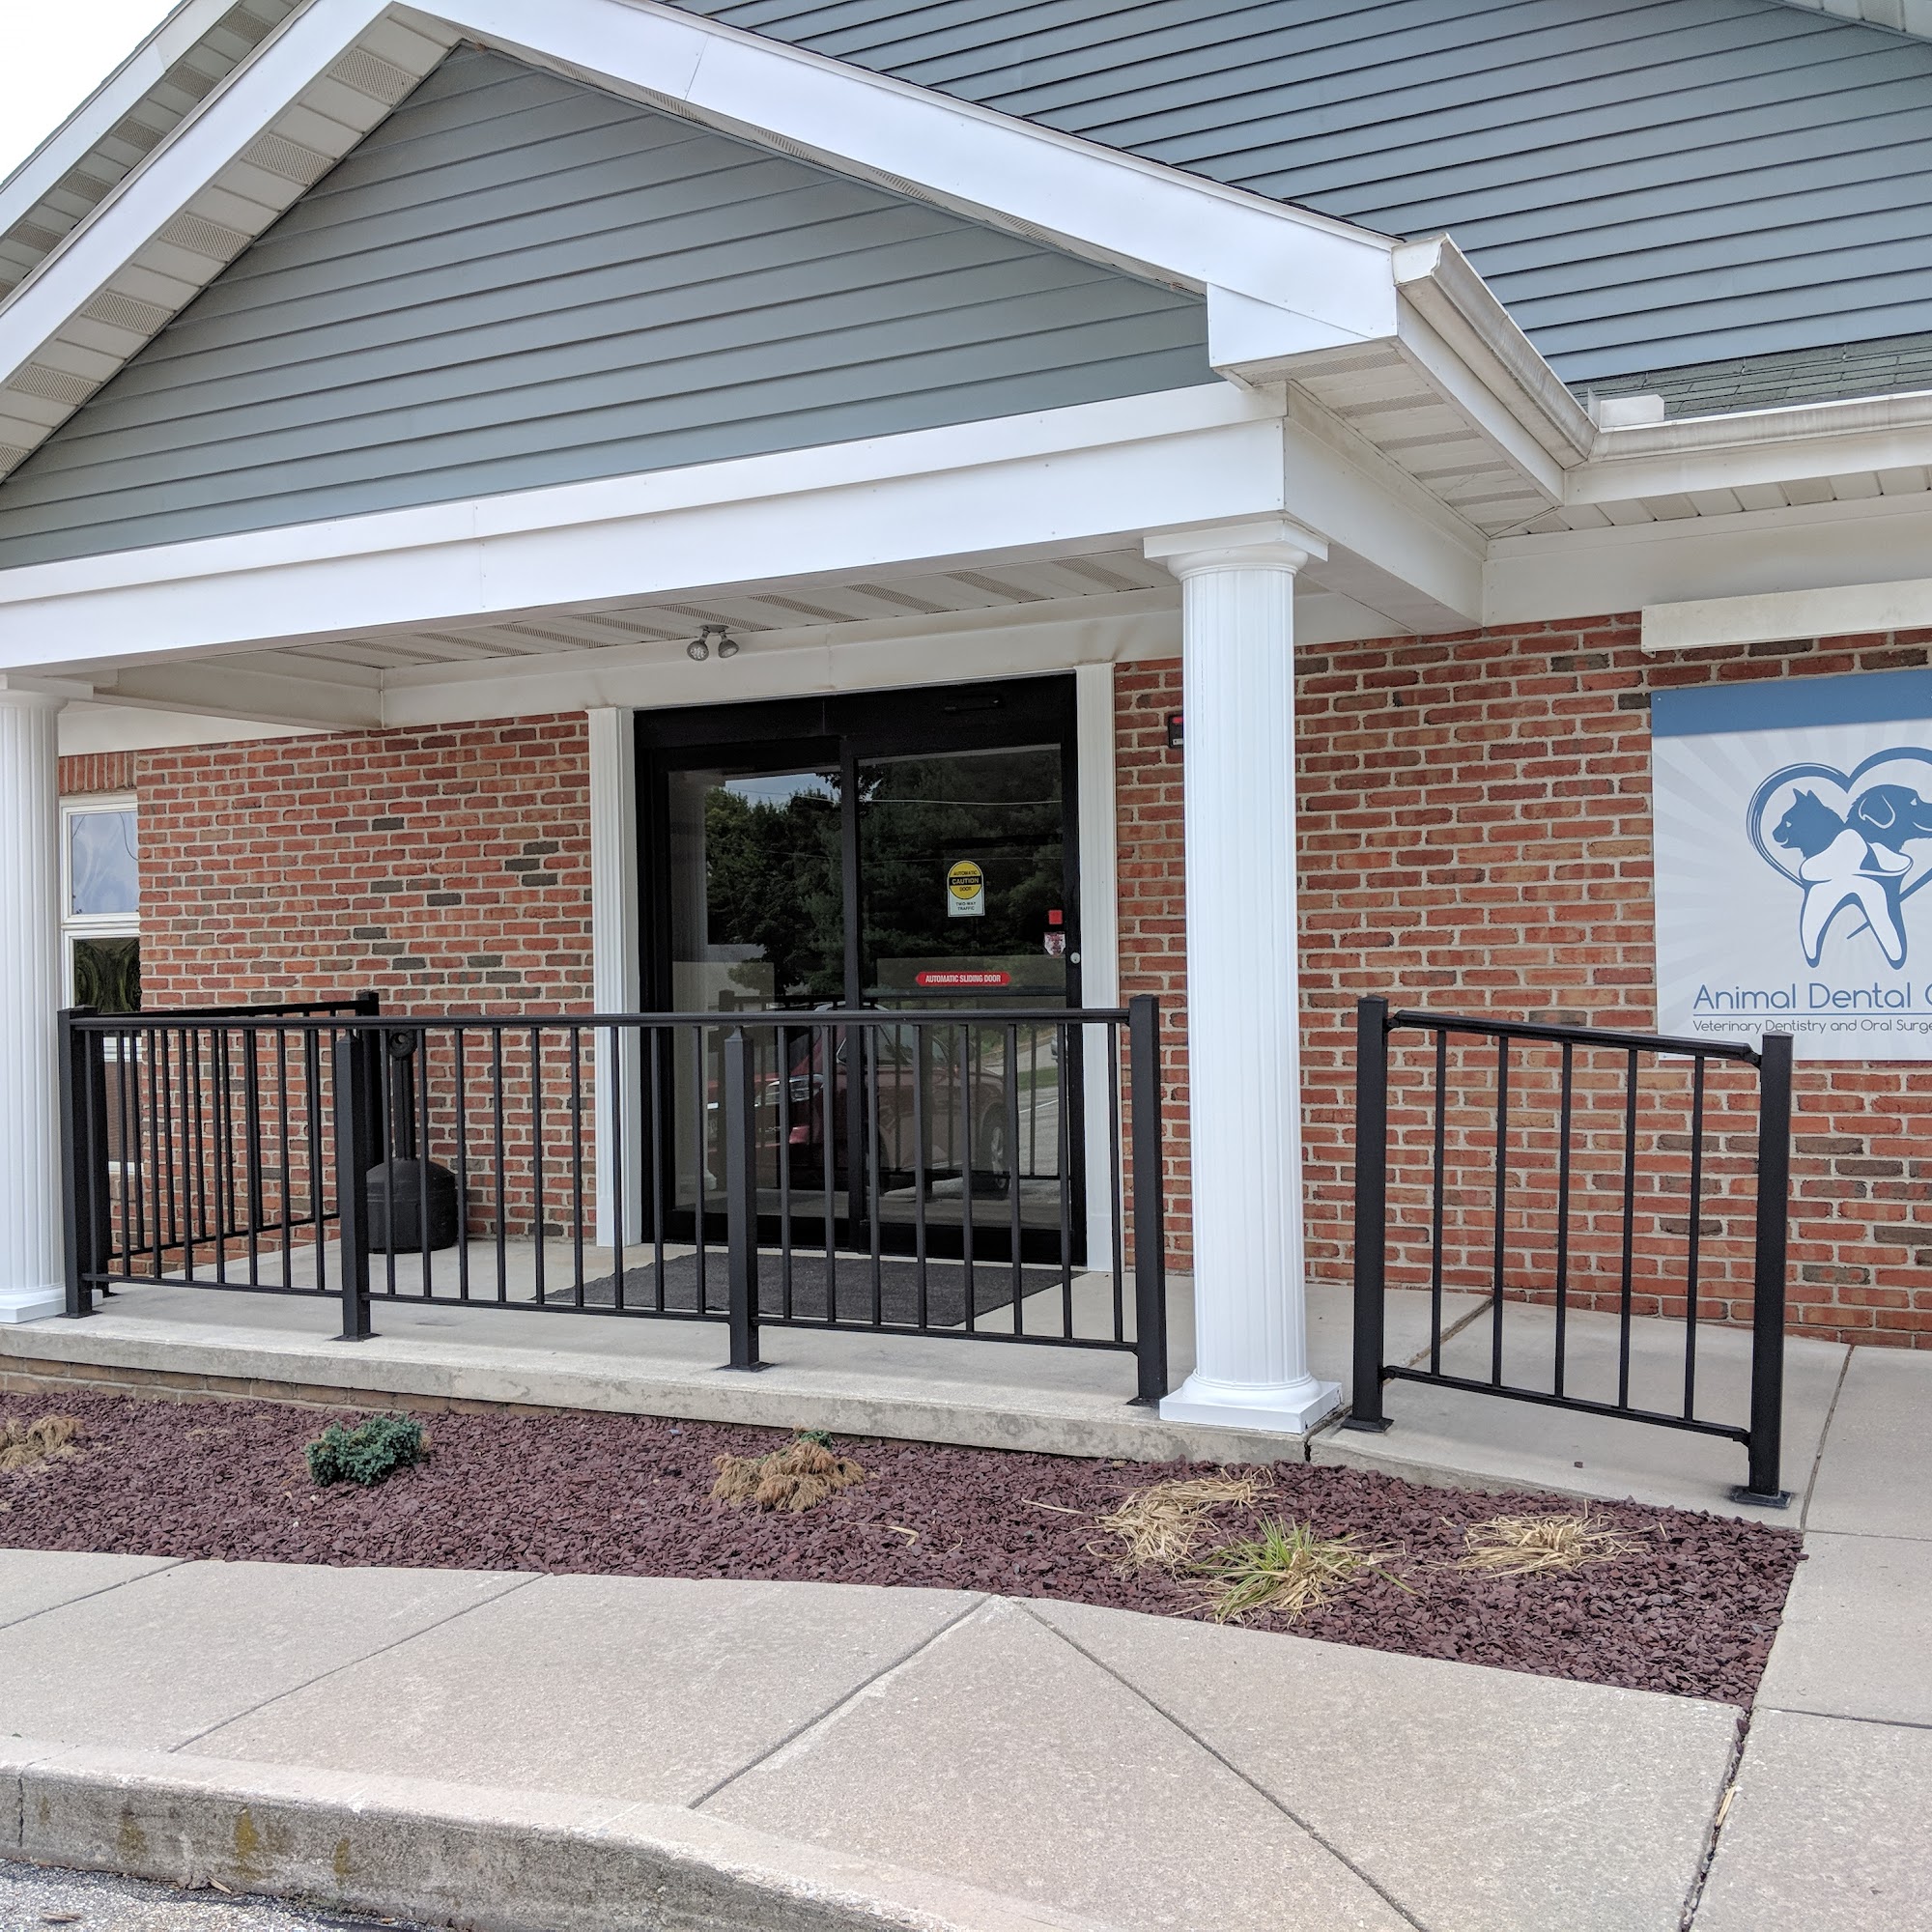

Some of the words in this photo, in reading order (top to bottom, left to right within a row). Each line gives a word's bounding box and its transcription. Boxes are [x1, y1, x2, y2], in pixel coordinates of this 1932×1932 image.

[1692, 983, 1796, 1009] Animal
[1808, 981, 1911, 1009] Dental
[1692, 1020, 1762, 1034] Veterinary
[1765, 1019, 1827, 1034] Dentistry
[1830, 1020, 1857, 1032] and
[1861, 1019, 1892, 1031] Oral
